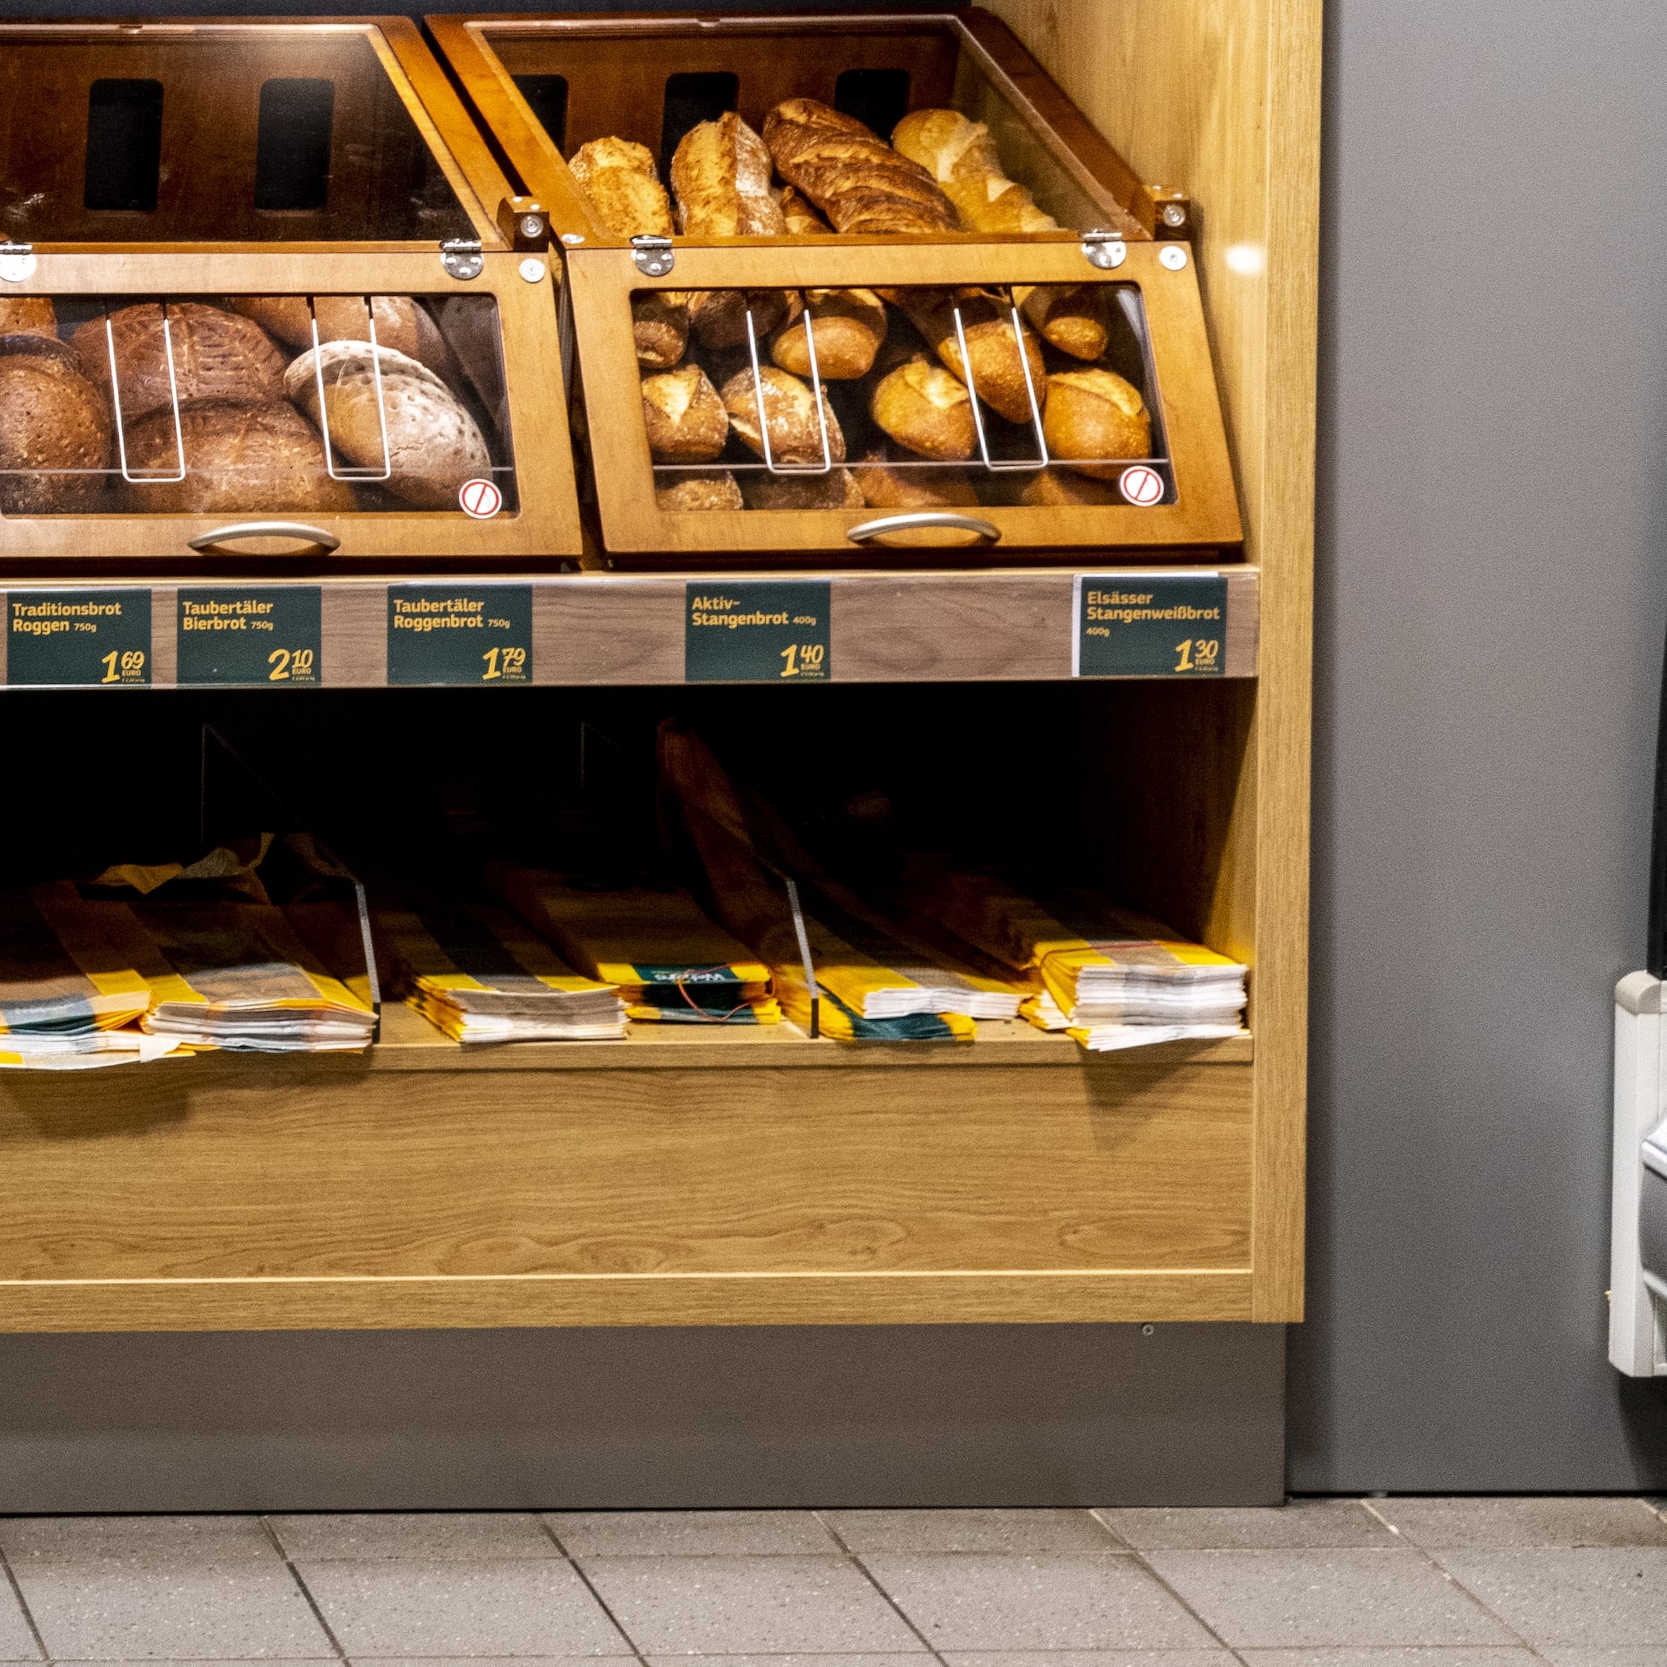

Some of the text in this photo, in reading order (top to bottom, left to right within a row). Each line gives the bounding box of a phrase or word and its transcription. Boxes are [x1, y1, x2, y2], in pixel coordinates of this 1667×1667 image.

[692, 597, 740, 610] Aktiv-
[1088, 591, 1153, 604] Elsässer
[13, 602, 122, 616] Traditionsbrot
[183, 600, 273, 614] Taubertäler
[394, 598, 484, 612] Taubertäler
[692, 611, 788, 628] Stangenbrot
[1087, 606, 1219, 623] Stangenweißbrot
[13, 619, 69, 635] Roggen
[184, 616, 246, 630] Bierbrot
[394, 614, 483, 631] Roggenbrot
